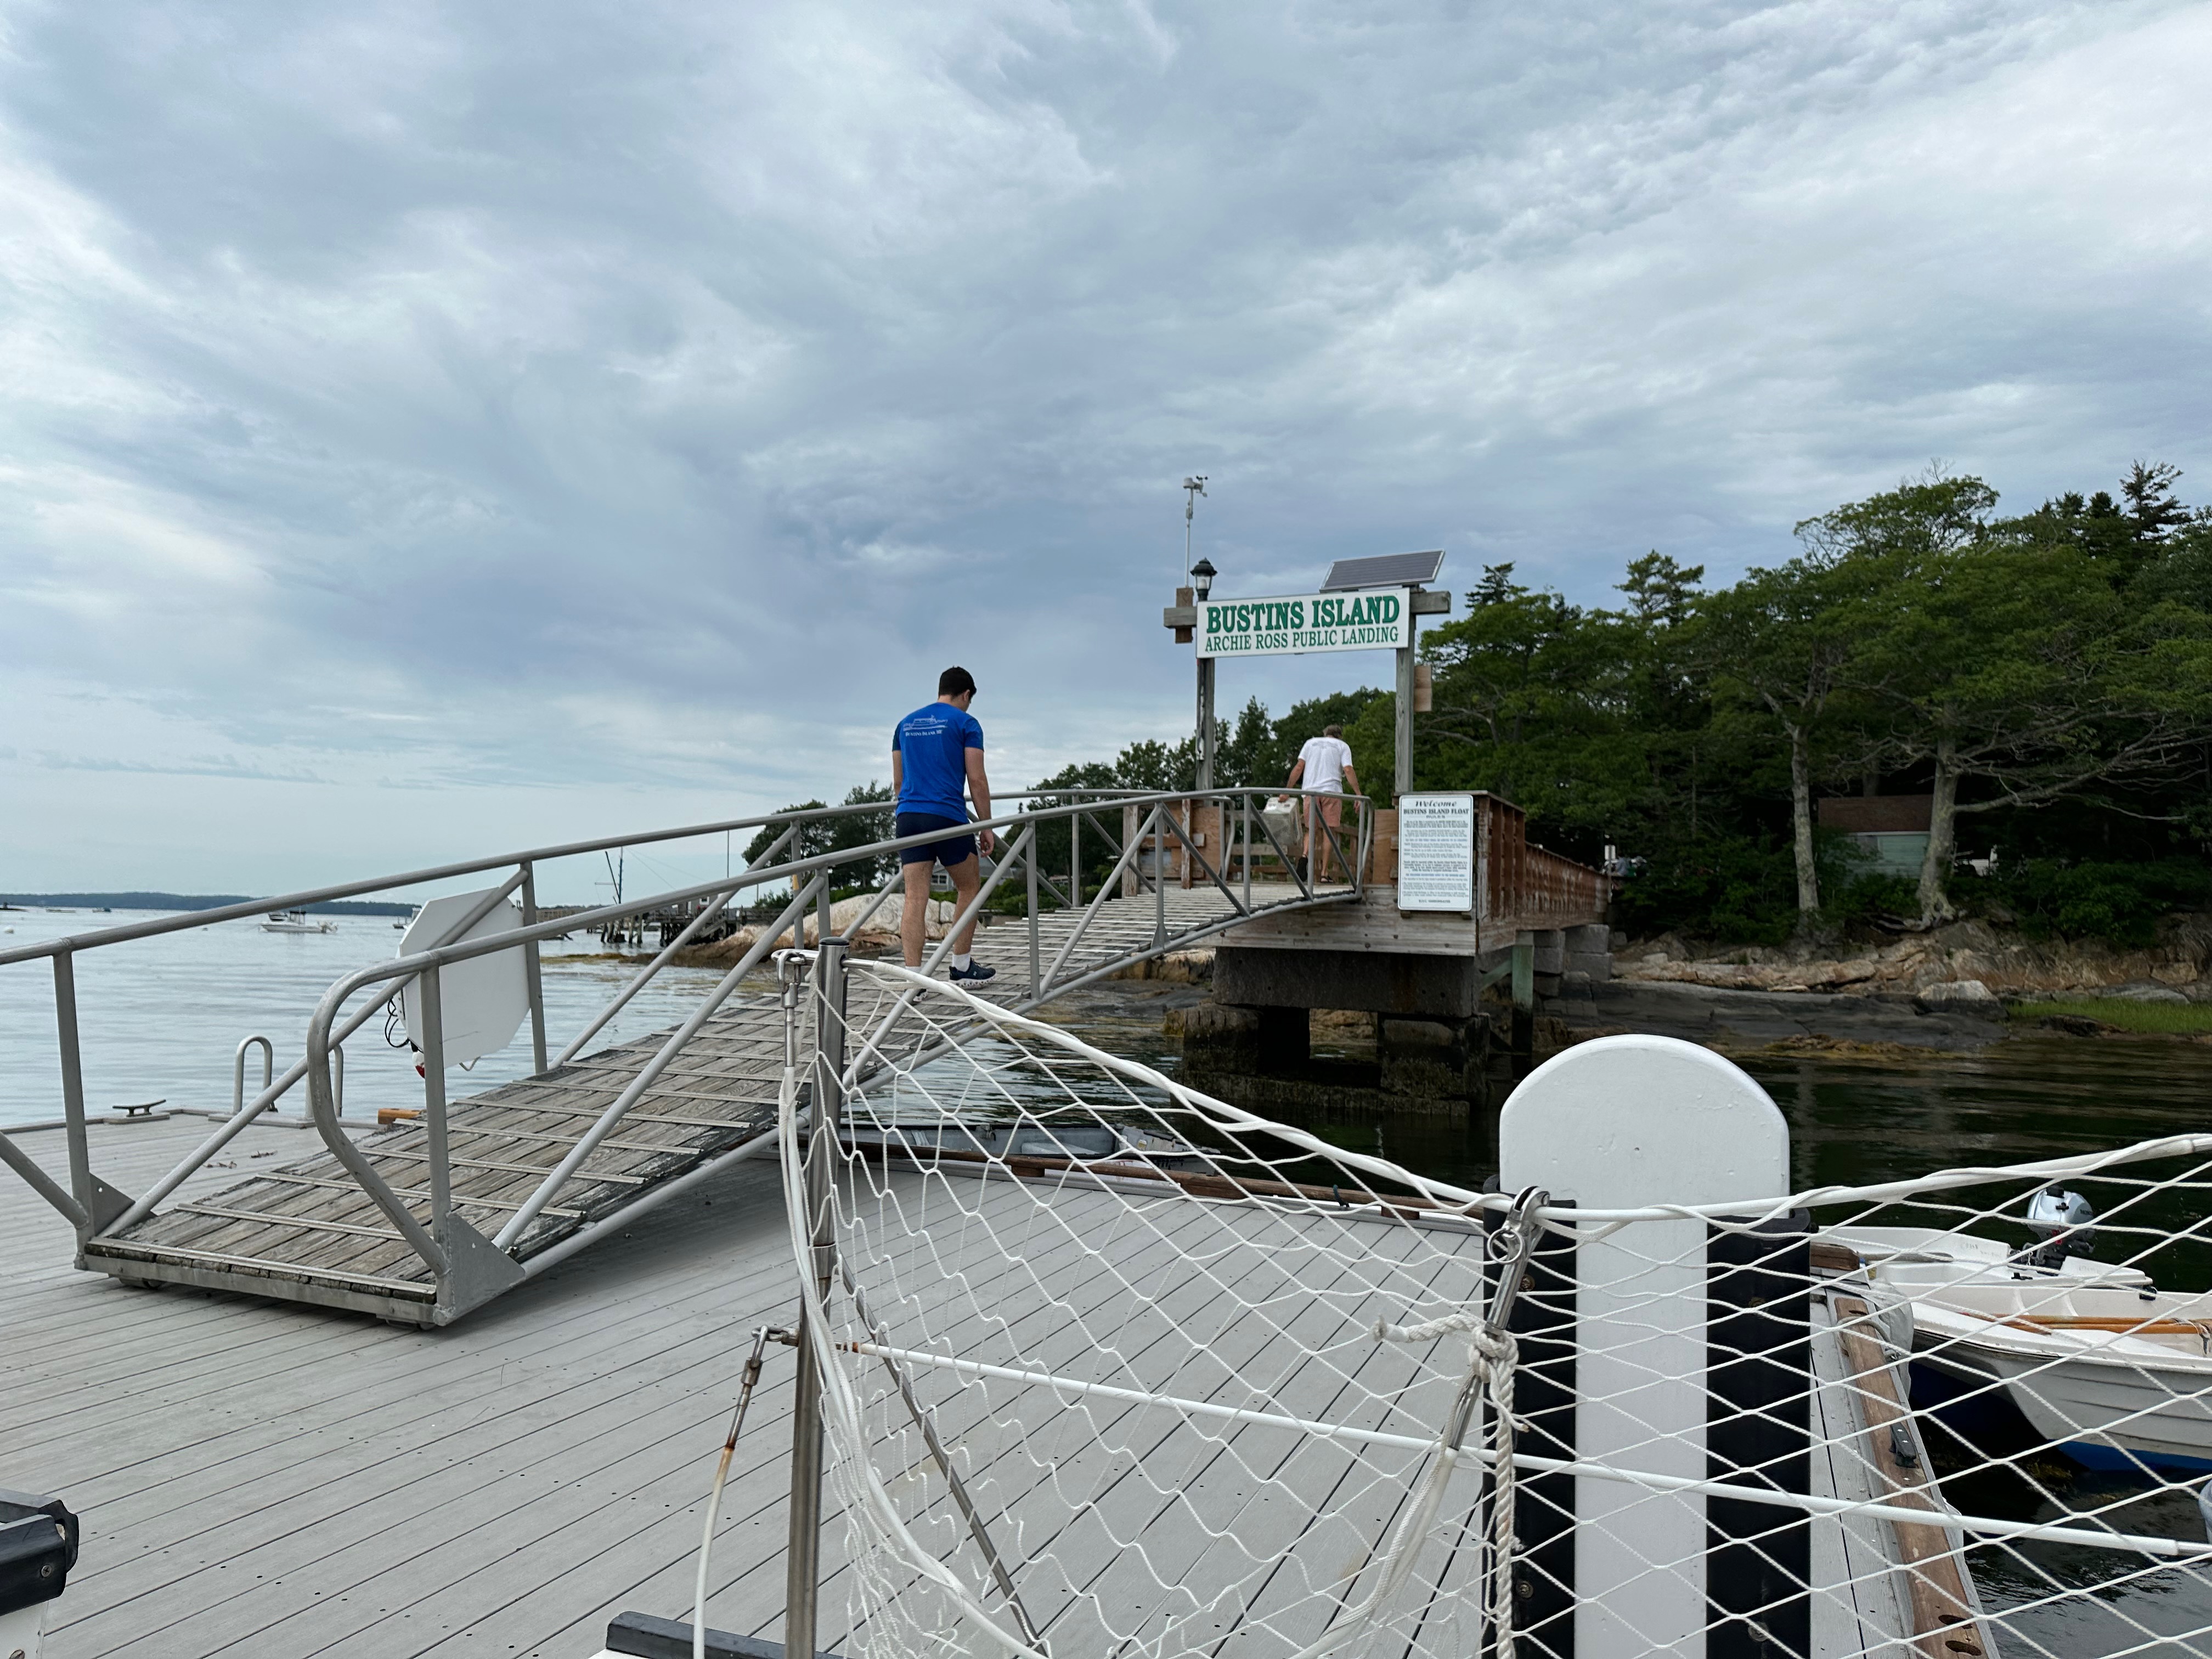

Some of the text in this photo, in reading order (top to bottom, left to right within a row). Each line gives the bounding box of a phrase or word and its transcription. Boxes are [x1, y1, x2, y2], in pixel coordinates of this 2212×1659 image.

[1206, 595, 1400, 633] BUSTINS ISLAND
[1205, 627, 1398, 652] ARCHIE ROSS PUBLIC LANDING
